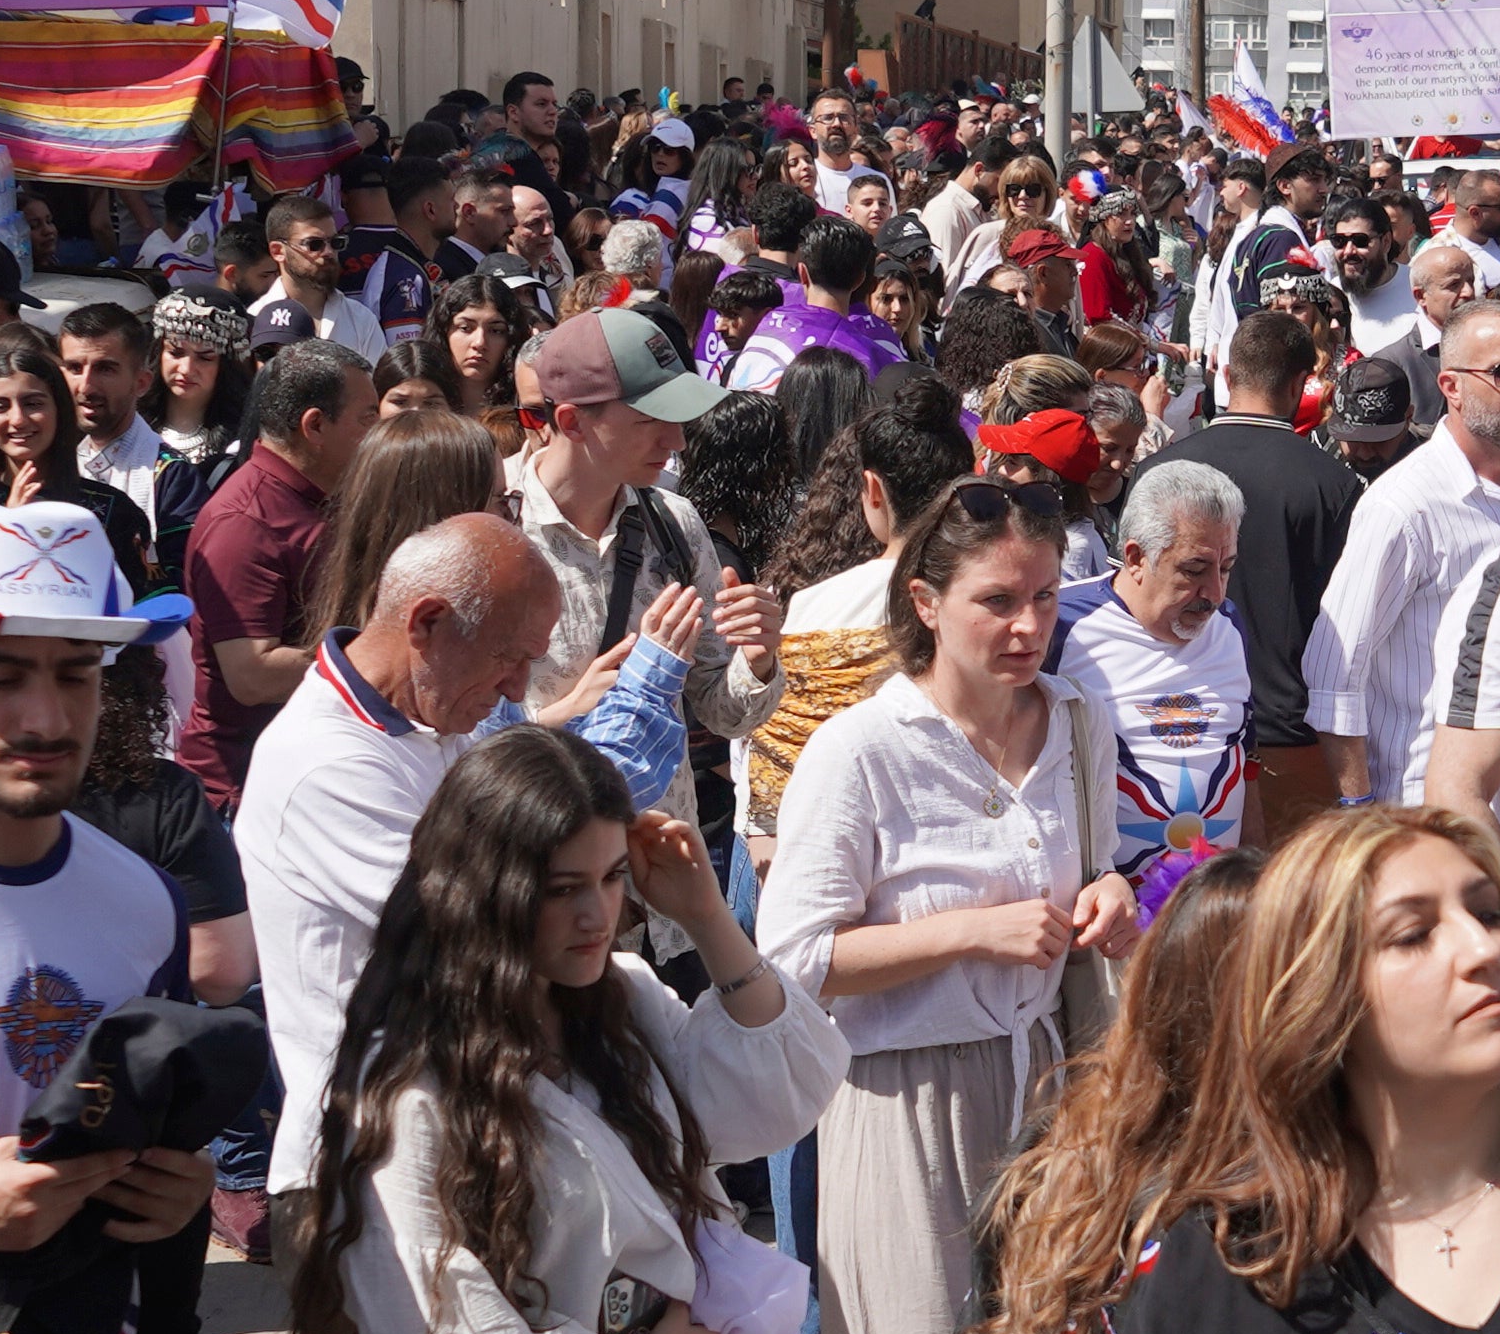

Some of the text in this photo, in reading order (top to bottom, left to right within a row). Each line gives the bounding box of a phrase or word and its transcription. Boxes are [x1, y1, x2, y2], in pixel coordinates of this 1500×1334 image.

[1365, 47, 1383, 60] 46
[1385, 50, 1411, 62] years
[1413, 49, 1424, 59] of
[1427, 47, 1464, 60] struggle
[1467, 47, 1478, 57] of
[1480, 48, 1497, 56] our
[1354, 63, 1409, 74] democratic
[1411, 61, 1466, 72] movement,
[1355, 78, 1372, 88] the
[1374, 77, 1396, 88] path
[1398, 76, 1408, 86] of
[1411, 76, 1428, 85] our
[1430, 73, 1467, 86] martyrs
[1438, 87, 1459, 98] with
[1461, 86, 1484, 97] their
